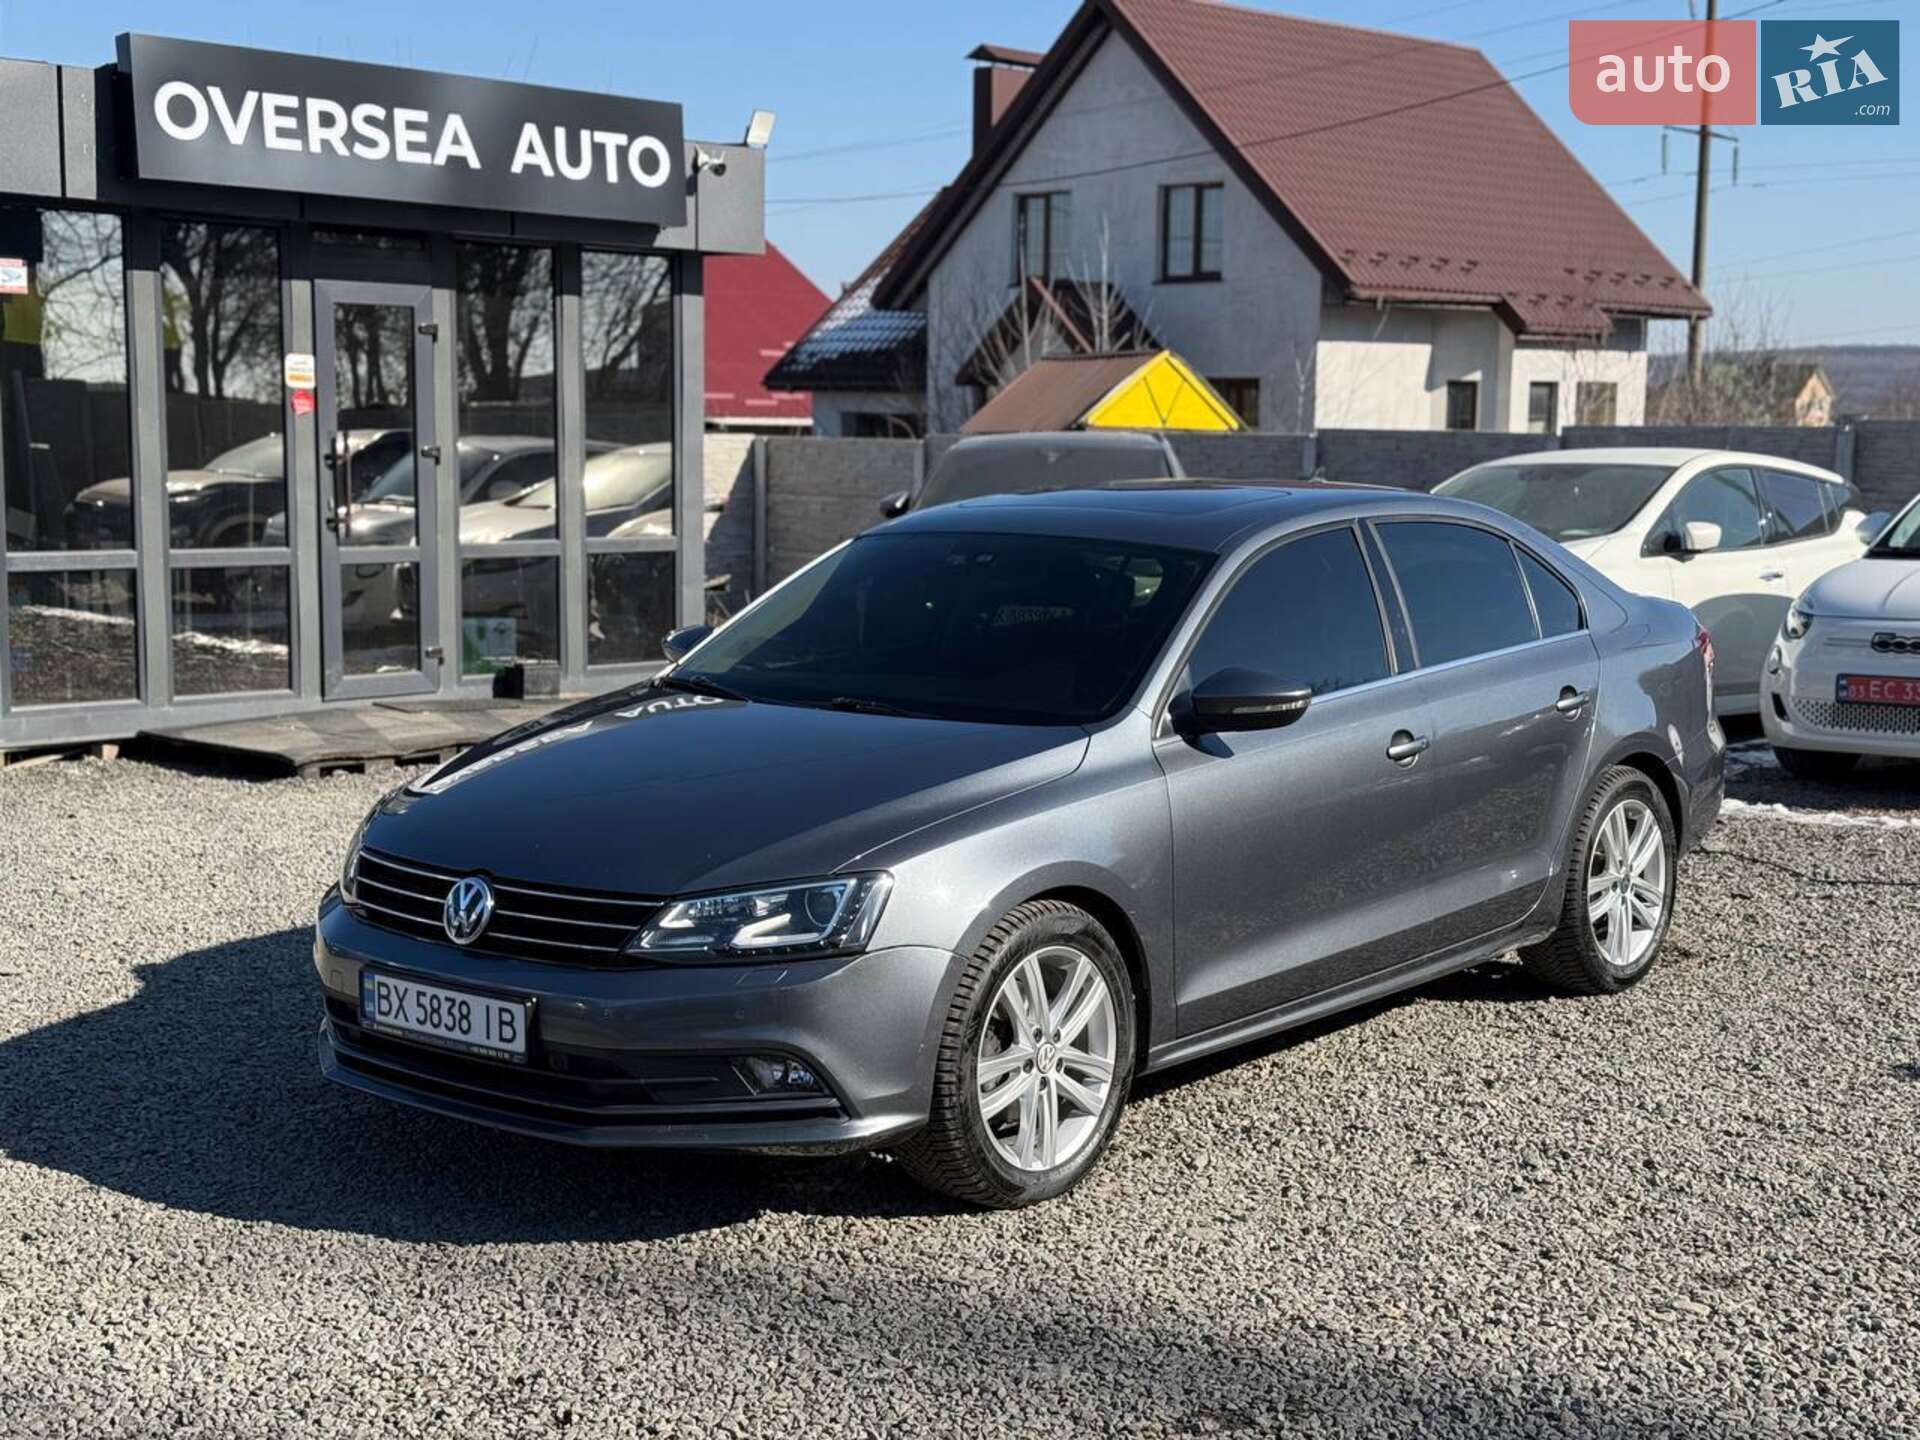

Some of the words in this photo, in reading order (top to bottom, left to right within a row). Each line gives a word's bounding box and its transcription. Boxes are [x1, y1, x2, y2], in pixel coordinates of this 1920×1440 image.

[153, 80, 482, 170] OVERSEA
[510, 121, 672, 188] AUTO
[1870, 680, 1897, 699] EC
[376, 981, 410, 1023] BX
[415, 989, 472, 1036] 5838
[485, 1004, 518, 1044] IB
